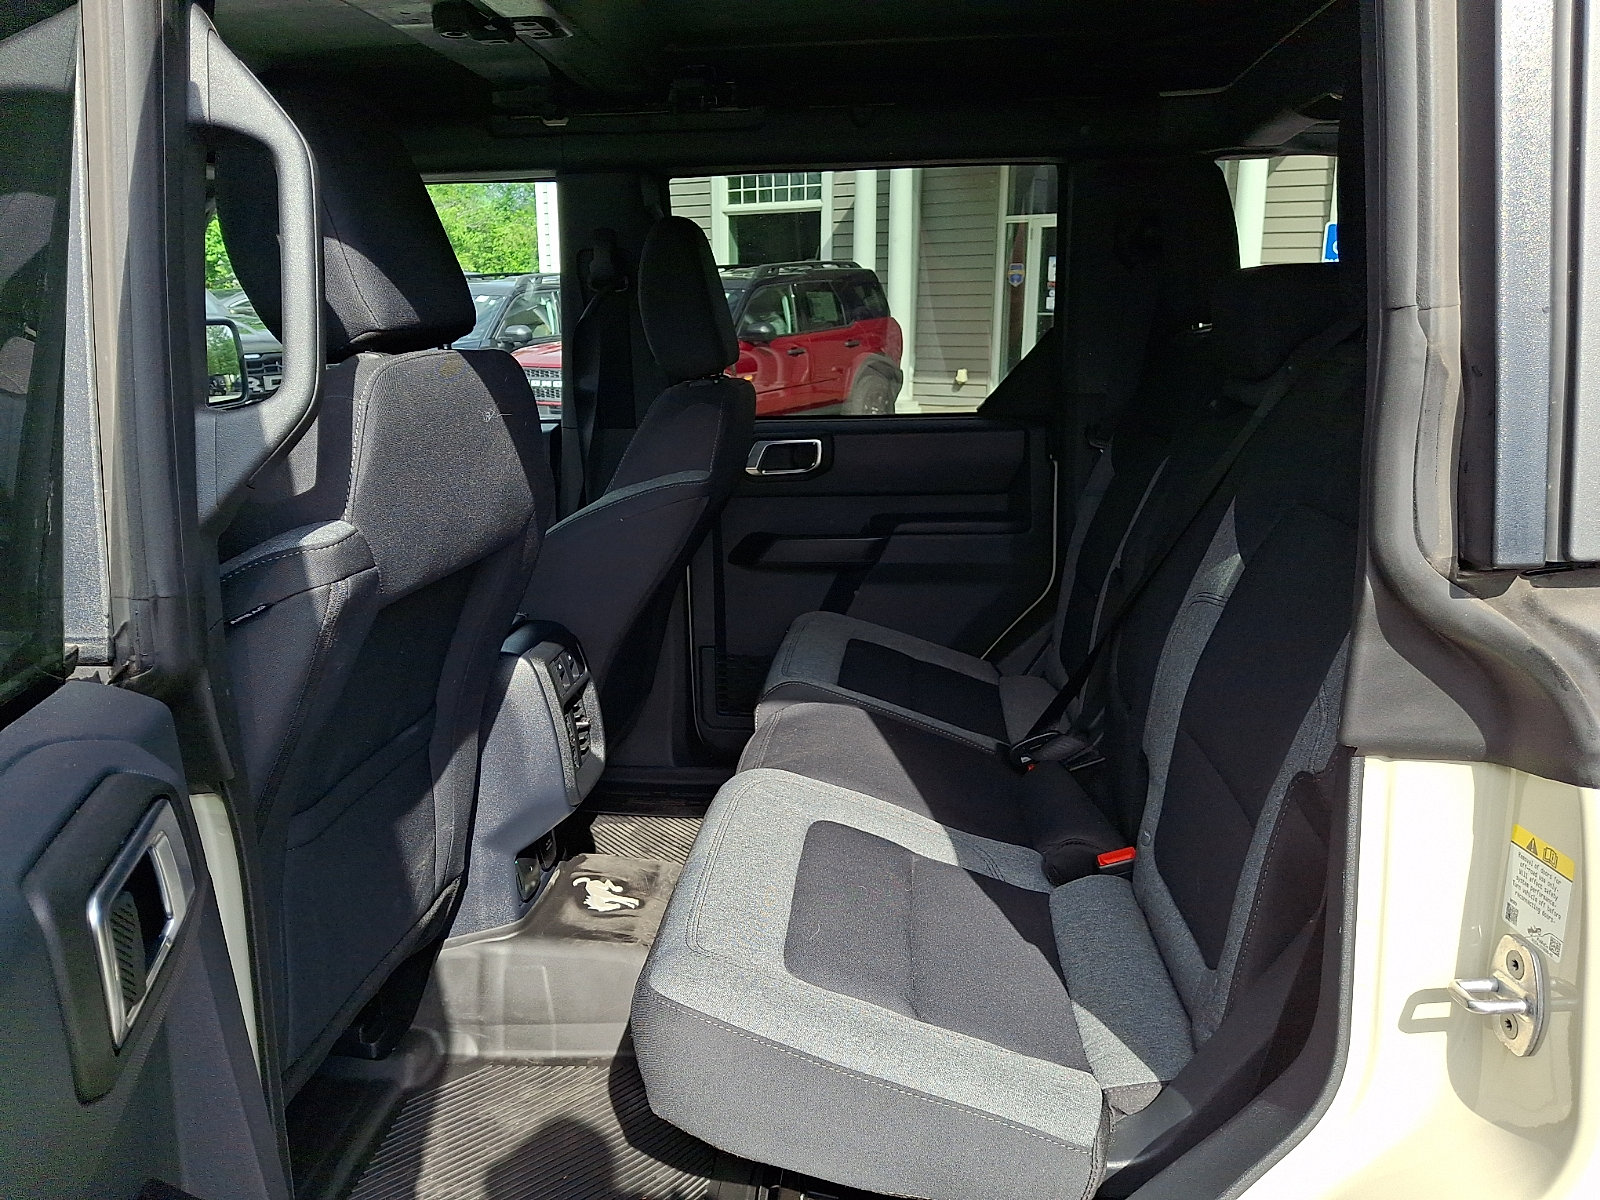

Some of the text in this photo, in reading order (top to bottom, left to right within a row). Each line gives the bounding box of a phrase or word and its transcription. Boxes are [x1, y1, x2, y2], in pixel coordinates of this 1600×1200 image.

[1518, 851, 1562, 885] Removal of doors for
[1518, 868, 1528, 880] Will
[1544, 887, 1559, 902] safety
[1522, 889, 1538, 903] vehicle
[1538, 899, 1546, 908] off
[1547, 904, 1562, 920] before
